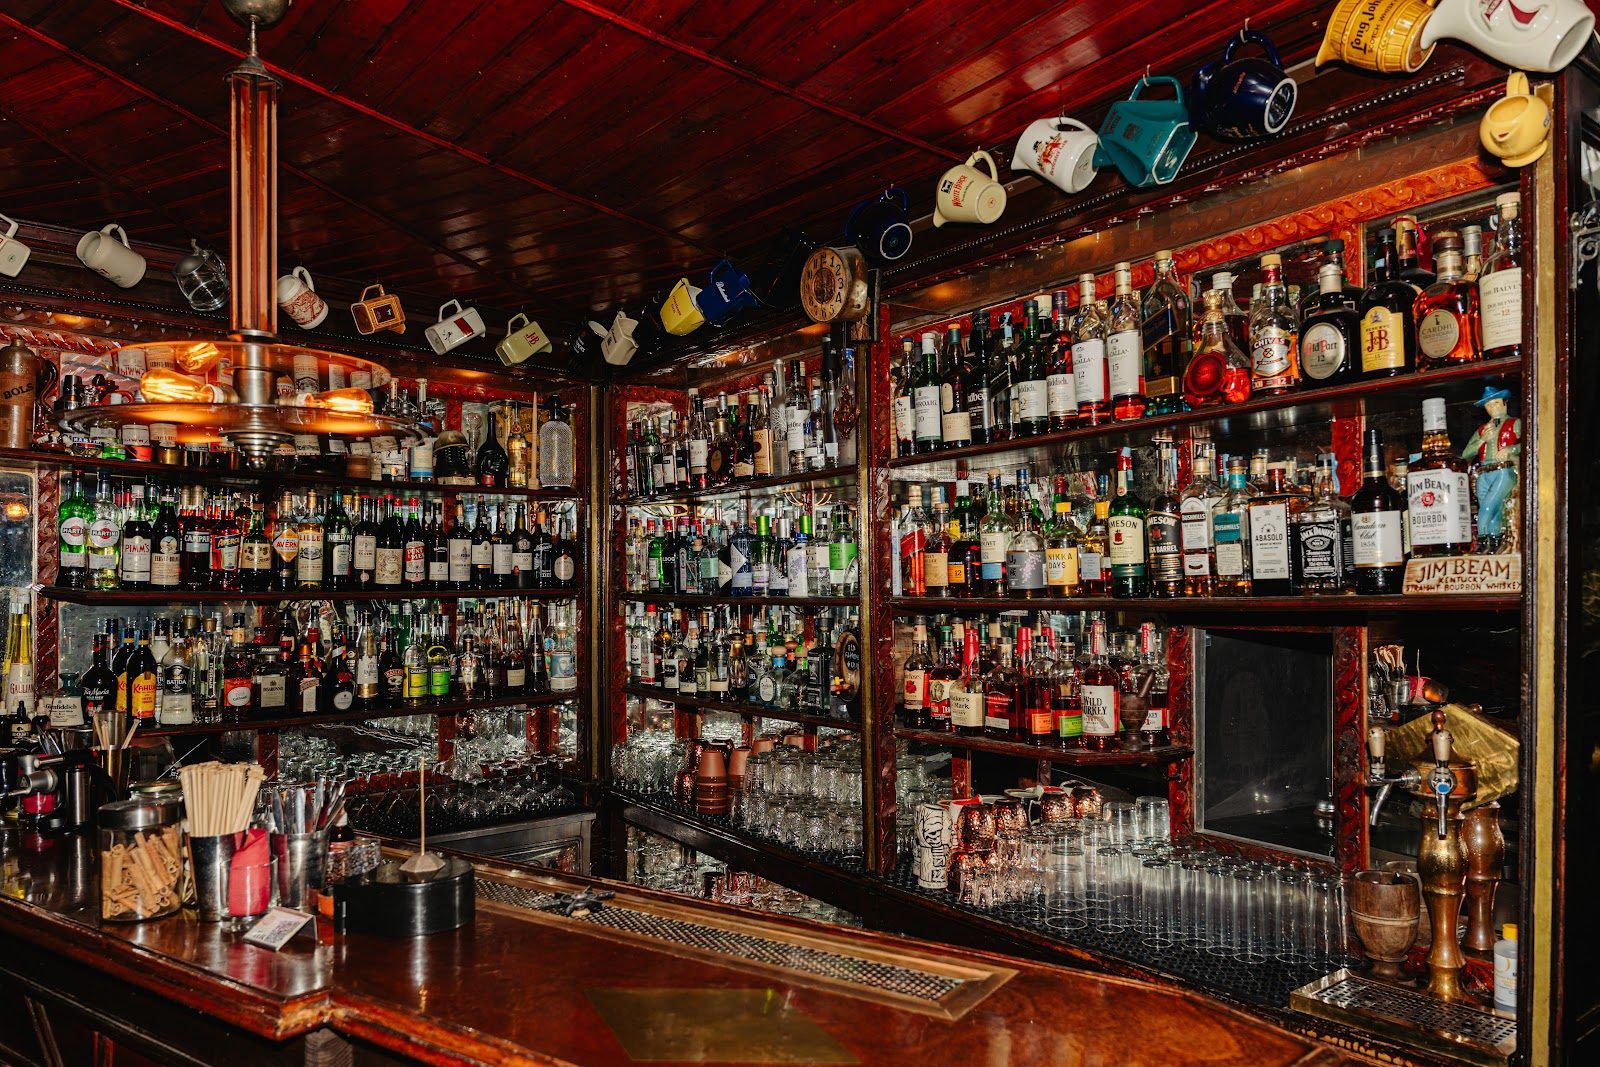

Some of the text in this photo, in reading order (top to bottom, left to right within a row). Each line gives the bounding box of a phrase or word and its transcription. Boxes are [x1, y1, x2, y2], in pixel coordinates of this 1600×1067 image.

[1350, 0, 1382, 55] Long Joh
[829, 256, 835, 267] 1
[835, 264, 841, 276] 2
[837, 277, 844, 290] 3
[835, 291, 842, 304] 4
[1421, 322, 1457, 336] CARDHU
[1253, 336, 1286, 349] CHIVAS
[1366, 328, 1390, 353] J&B
[1317, 354, 1325, 363] 12
[1112, 363, 1119, 372] 15
[1078, 370, 1086, 379] 12
[3, 382, 34, 400] BOLS
[1408, 477, 1451, 498] JIM BEAM
[1109, 519, 1138, 530] MESON
[1148, 516, 1177, 527] MESON
[1412, 514, 1448, 525] BOURBON
[91, 529, 119, 537] MARTINI
[1254, 532, 1284, 542] ABASOLO
[1299, 528, 1314, 542] JACK
[1359, 530, 1377, 540] Club
[125, 543, 150, 553] PIMM'S
[1156, 544, 1179, 554] BARREL
[1048, 552, 1073, 561] NIKKA
[1048, 561, 1066, 569] DAYS
[1415, 557, 1511, 584] JIM BEAM
[1438, 575, 1487, 584] KENTUCKY
[1443, 582, 1482, 592] BOURBON
[1485, 580, 1522, 590] WHISKEY
[1083, 695, 1103, 707] WILD
[1083, 706, 1108, 717] URKEY
